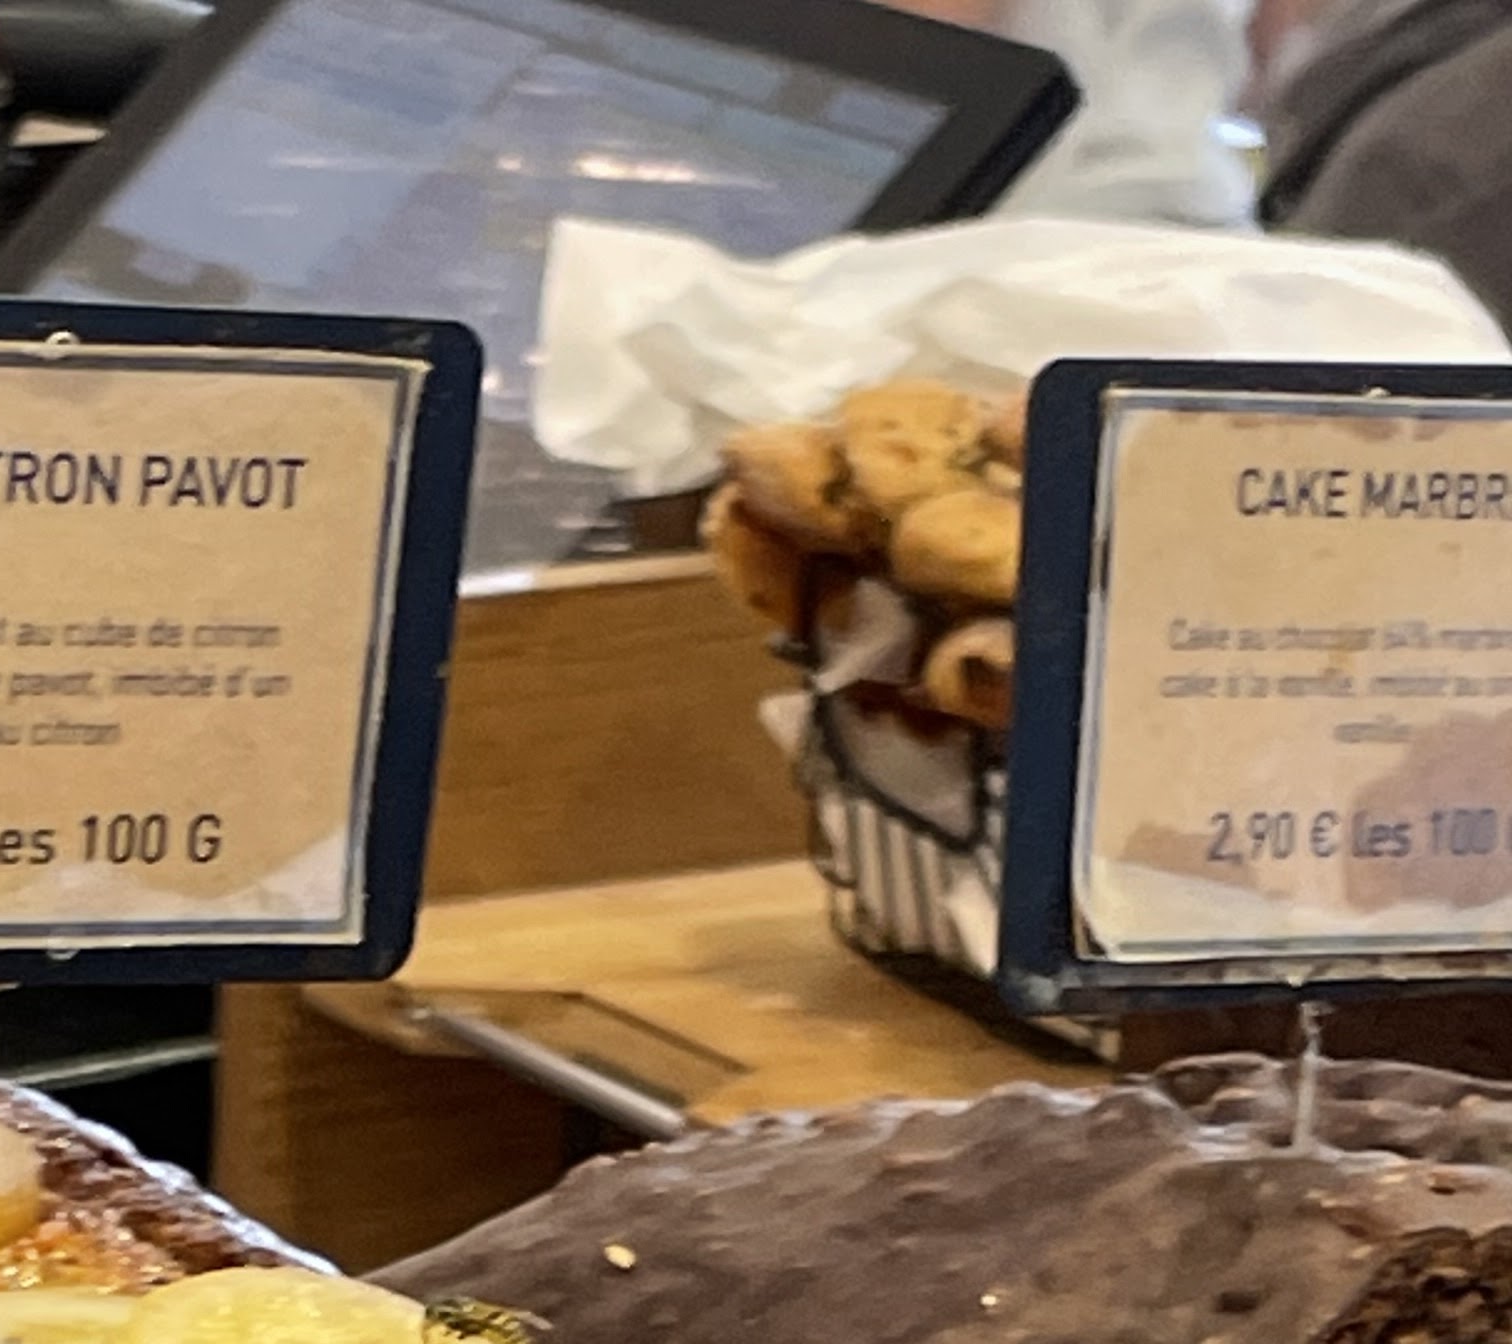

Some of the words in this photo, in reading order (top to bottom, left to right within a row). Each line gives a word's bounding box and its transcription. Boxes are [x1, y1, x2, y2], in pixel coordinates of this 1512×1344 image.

[138, 455, 309, 509] PAVOT
[1238, 468, 1349, 518] CAKE
[81, 812, 170, 866] 100
[187, 812, 224, 865] G
[1206, 810, 1296, 864] 2,90
[1309, 810, 1340, 859] €
[1351, 809, 1414, 859] les
